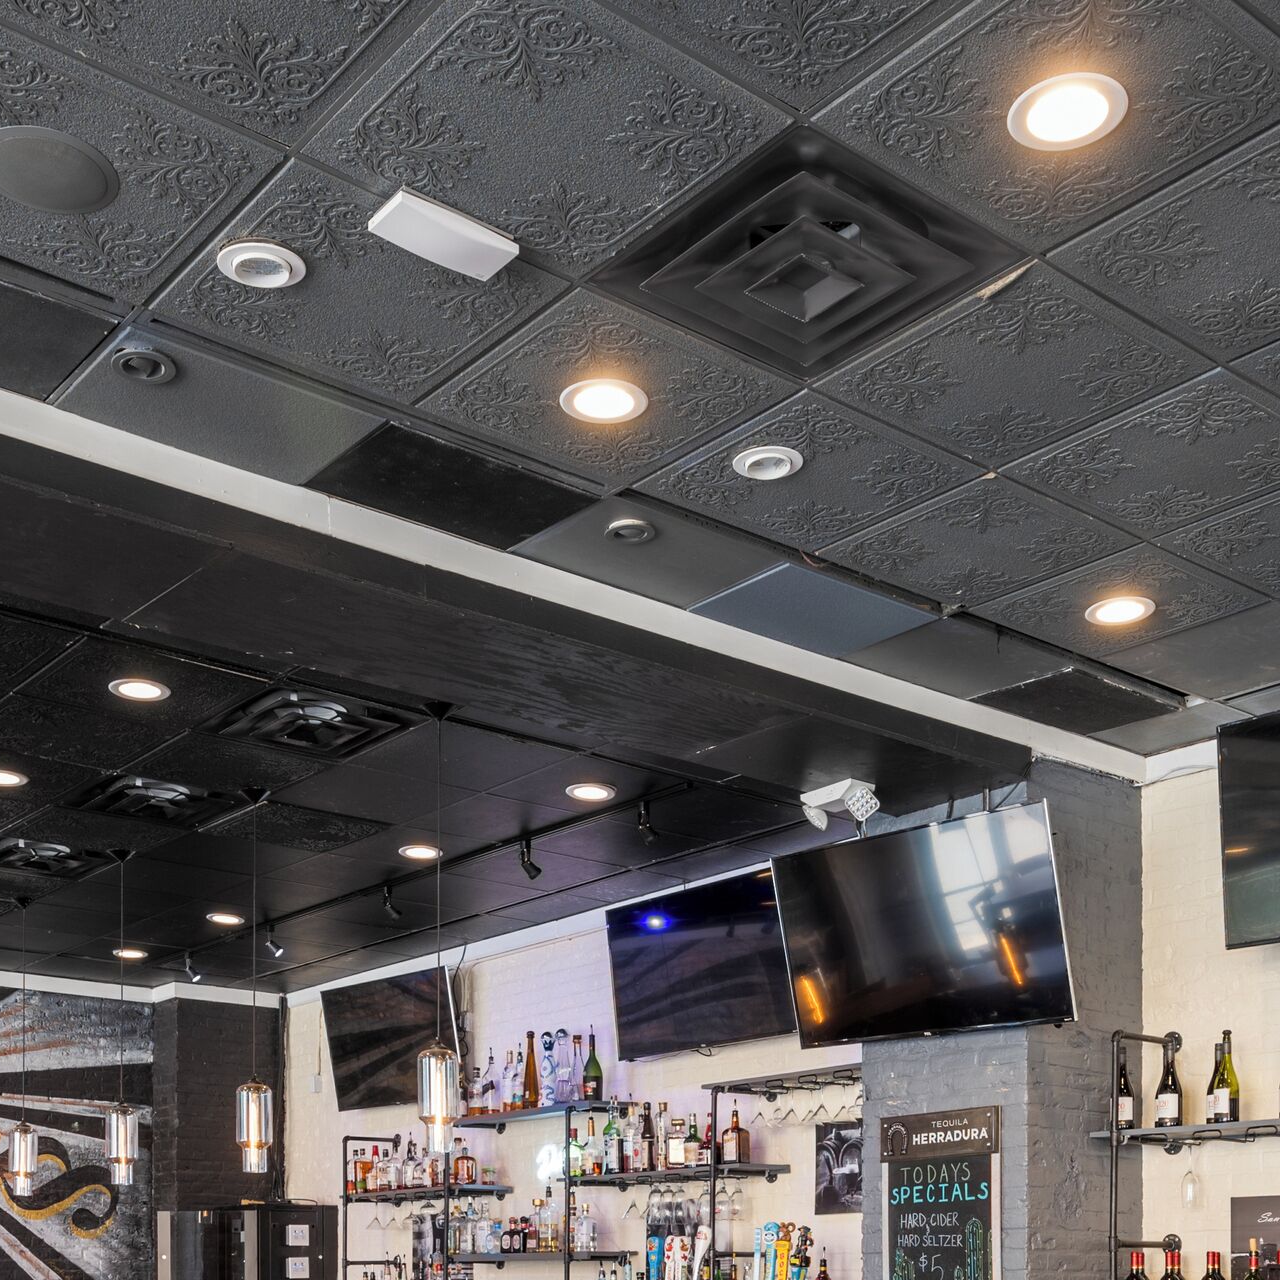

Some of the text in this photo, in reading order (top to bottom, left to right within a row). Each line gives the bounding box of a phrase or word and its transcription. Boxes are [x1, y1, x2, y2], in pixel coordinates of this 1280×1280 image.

[931, 1118, 969, 1128] TEQUILA
[912, 1128, 989, 1146] HERRADURA
[900, 1162, 971, 1185] TODAYS
[890, 1182, 989, 1205] SPECIALS
[900, 1211, 960, 1229] HARD CIDER
[1257, 1212, 1280, 1223] San
[897, 1233, 964, 1248] HARD SELTZER
